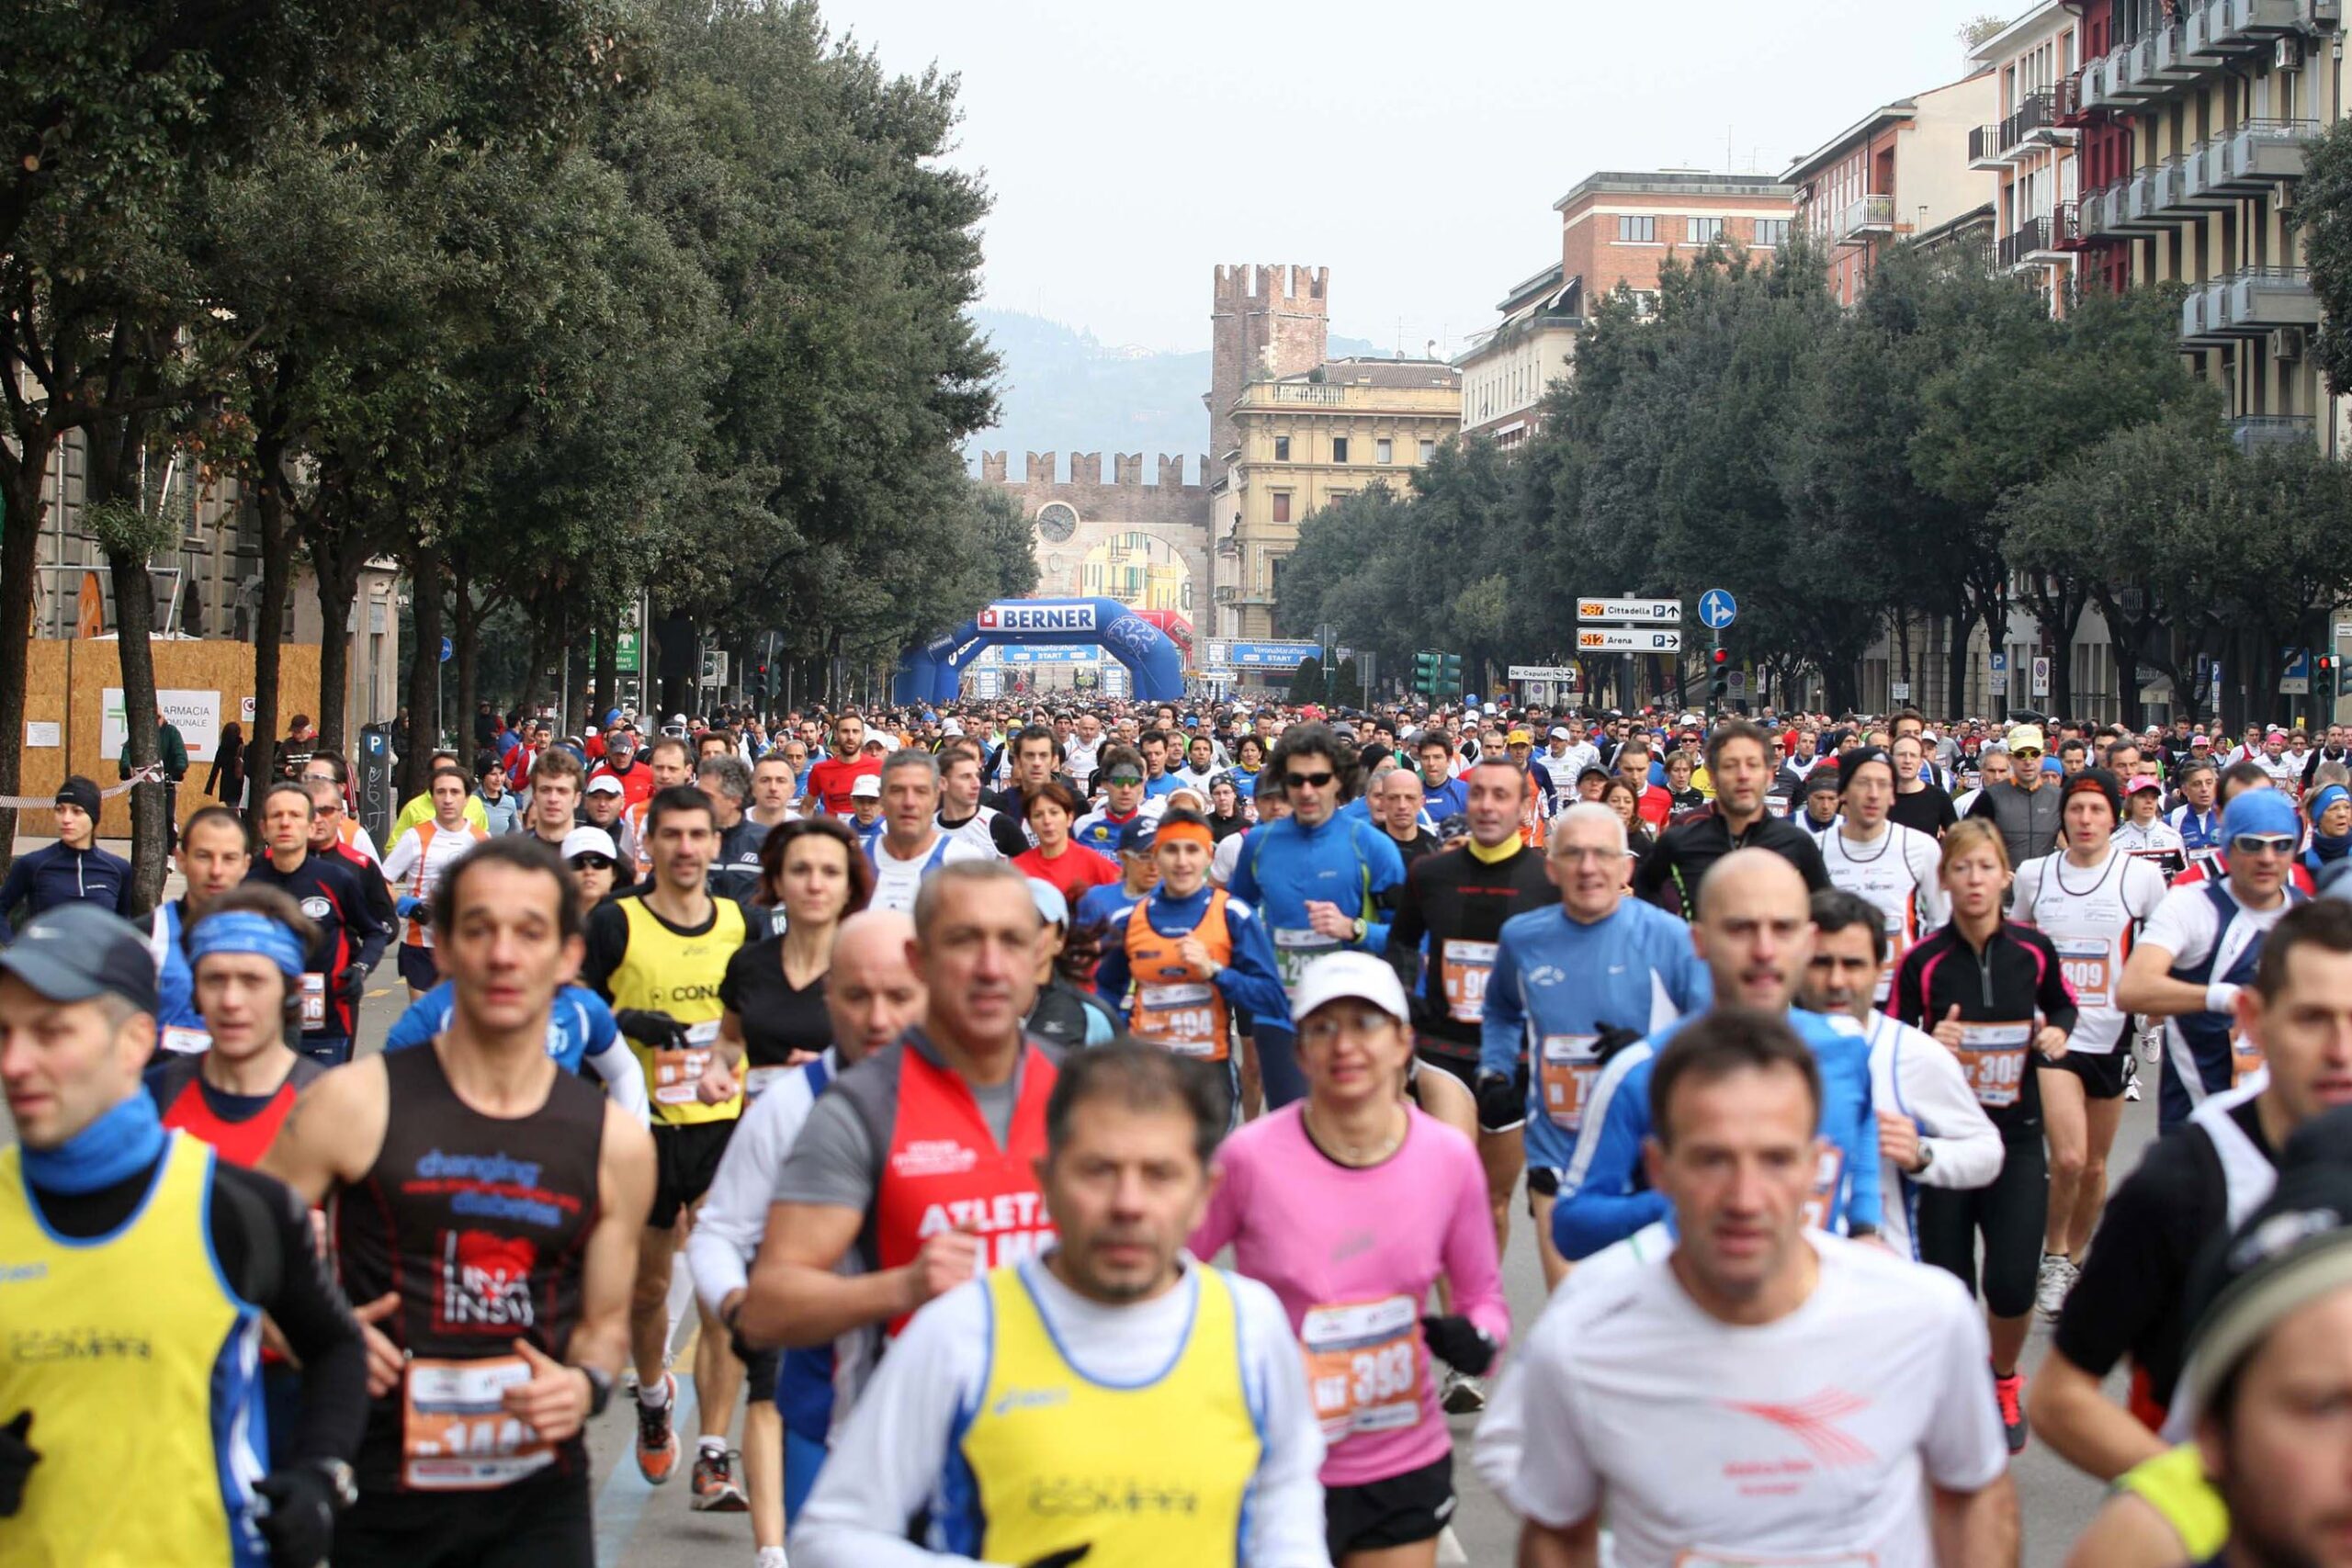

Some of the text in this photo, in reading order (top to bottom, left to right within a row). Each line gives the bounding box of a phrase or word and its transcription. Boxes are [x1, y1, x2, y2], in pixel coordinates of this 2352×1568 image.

[1581, 604, 1603, 615] 587
[1608, 606, 1650, 615] Cittadella
[1004, 610, 1092, 627] BERNER
[1581, 634, 1603, 645] 512
[164, 705, 209, 716] ARMACIA
[673, 986, 721, 1002] CON
